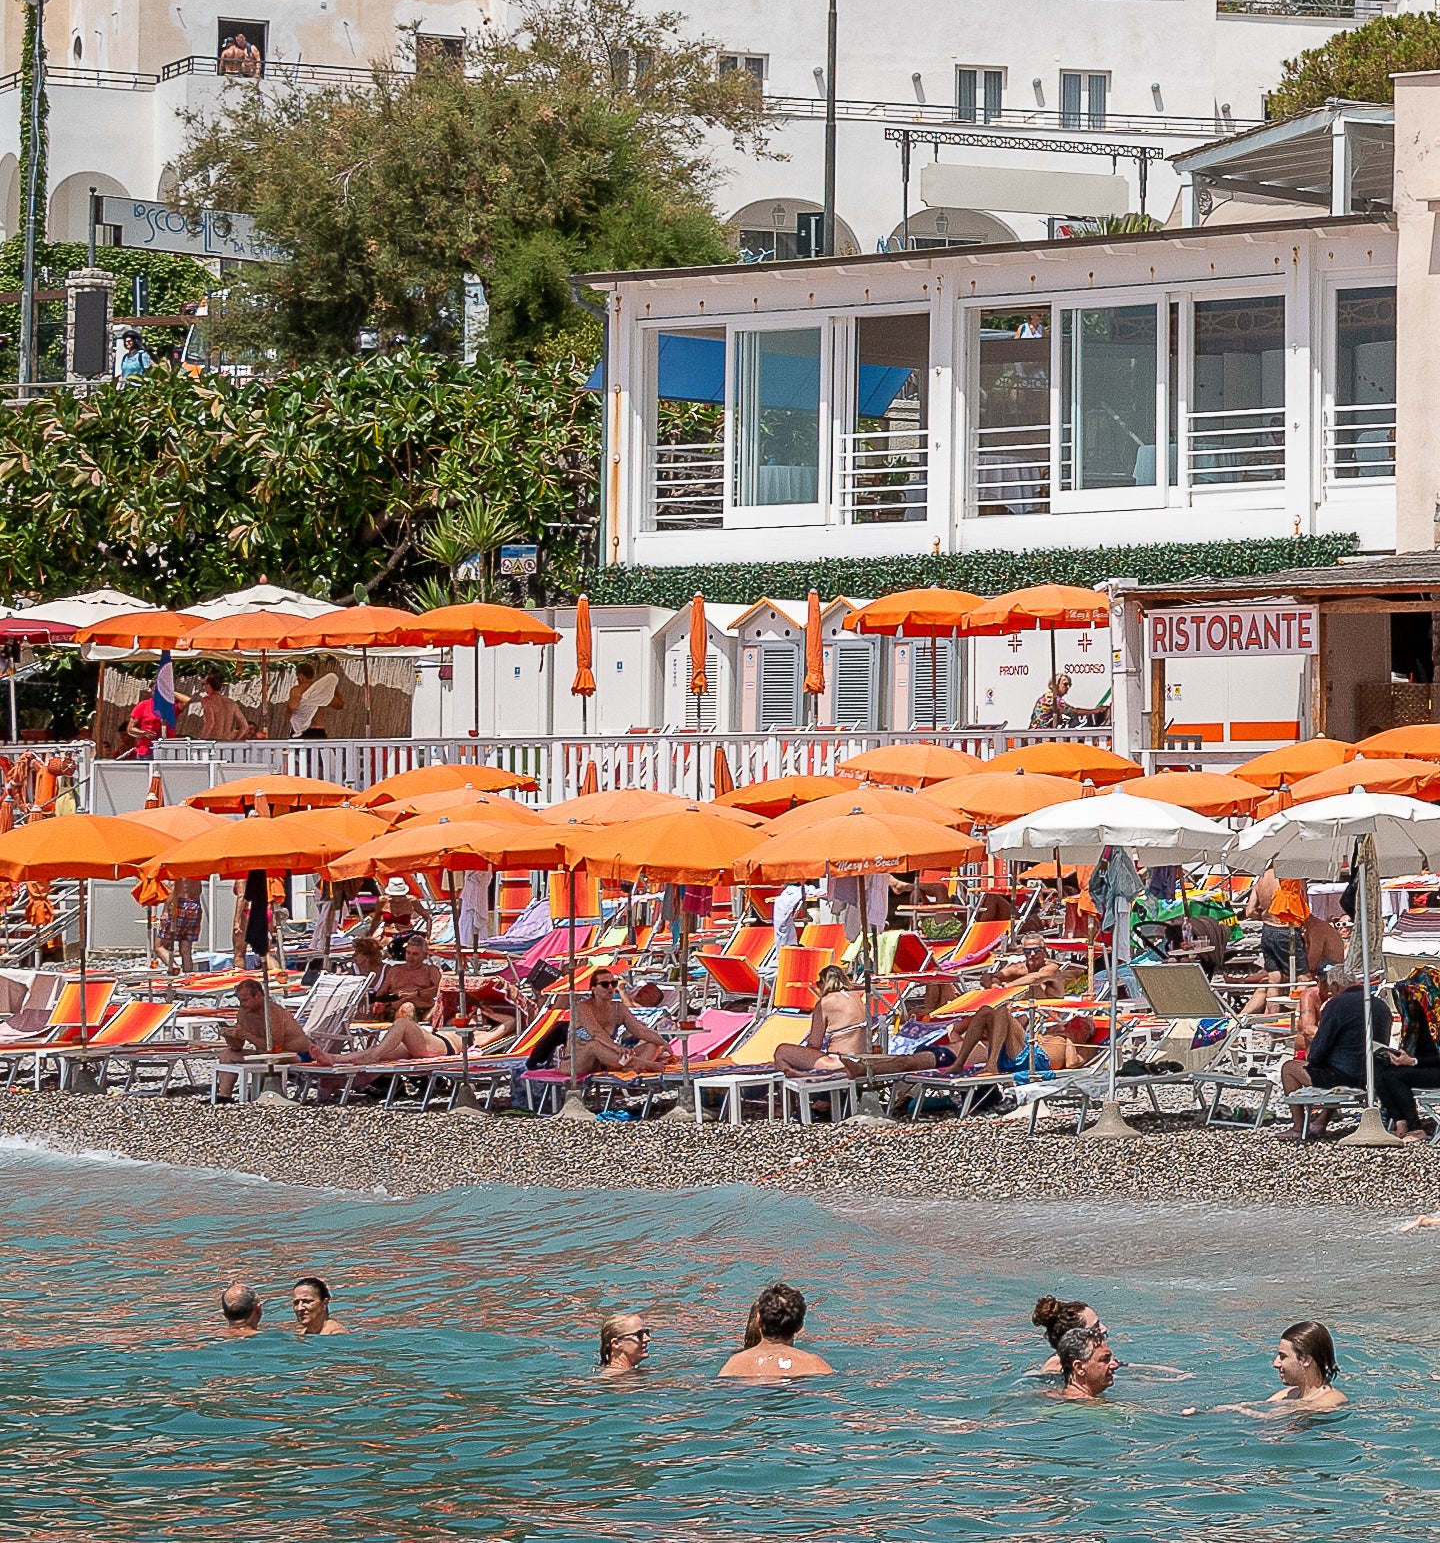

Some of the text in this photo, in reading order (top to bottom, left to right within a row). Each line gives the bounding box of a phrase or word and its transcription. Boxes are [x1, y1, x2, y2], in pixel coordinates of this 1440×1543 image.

[1152, 612, 1313, 653] RISTORANTE
[999, 664, 1029, 677] PRONTO
[1064, 663, 1105, 675] SOCCORSO
[836, 855, 900, 872] Mary's Beach
